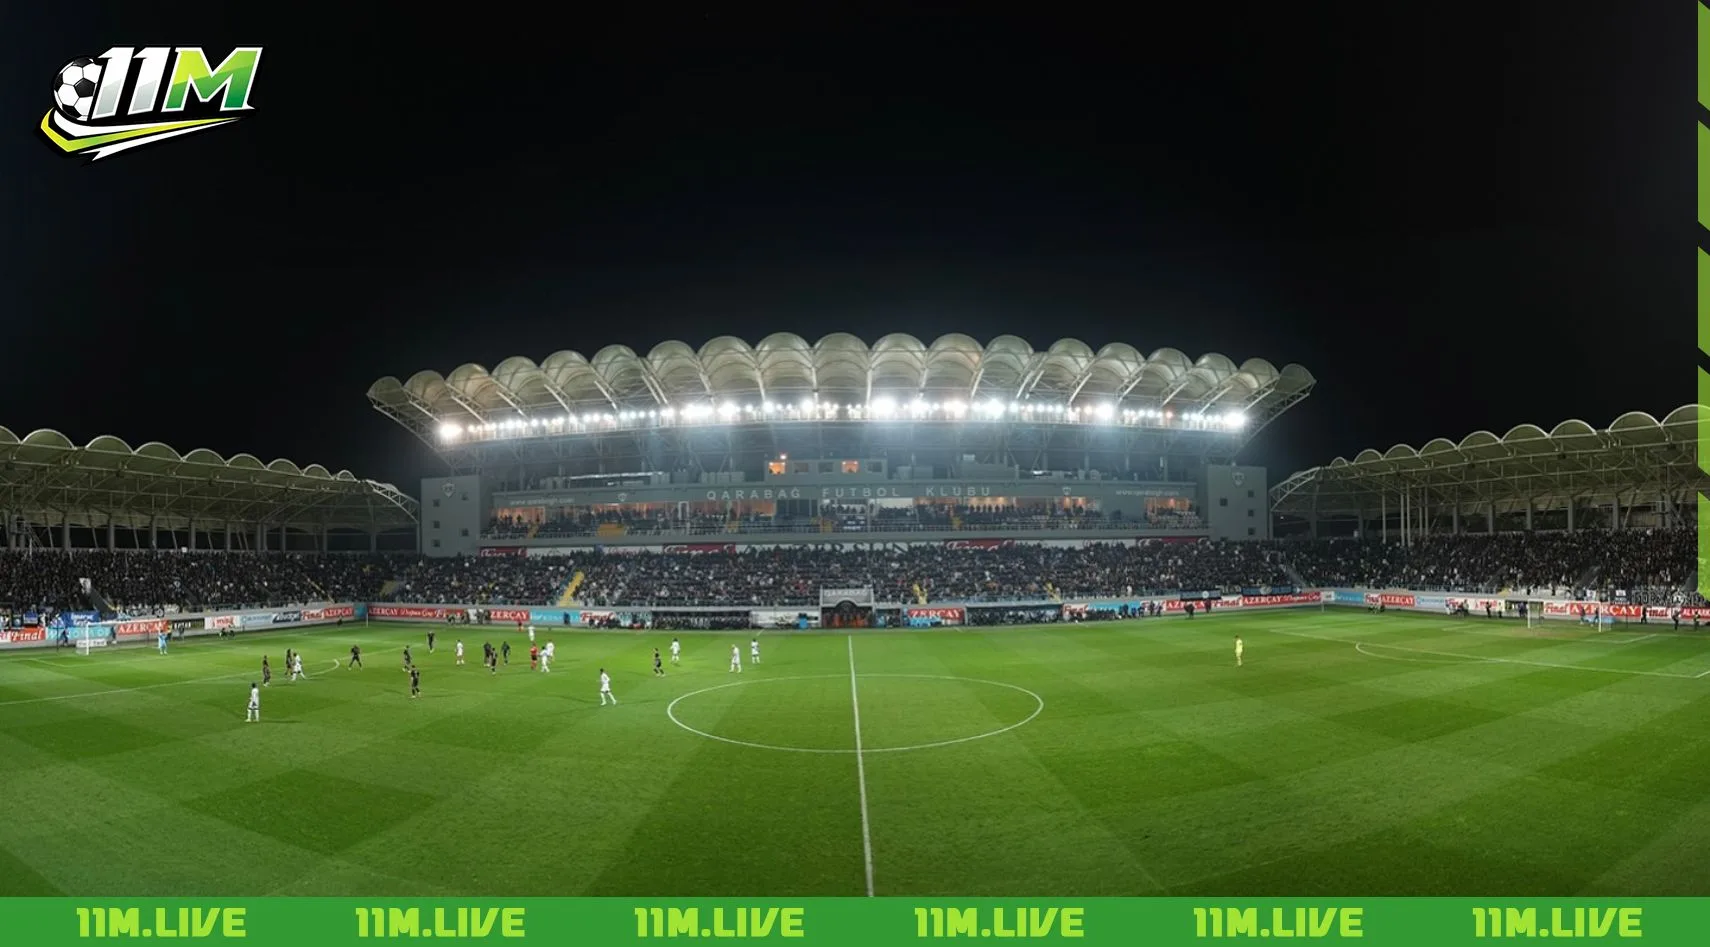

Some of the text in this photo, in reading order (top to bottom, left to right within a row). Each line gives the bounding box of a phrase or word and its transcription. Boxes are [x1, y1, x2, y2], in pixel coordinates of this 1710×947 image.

[706, 486, 990, 500] QARABAĞ FUTBOL KLUBU
[490, 611, 528, 620] ZERÇAY
